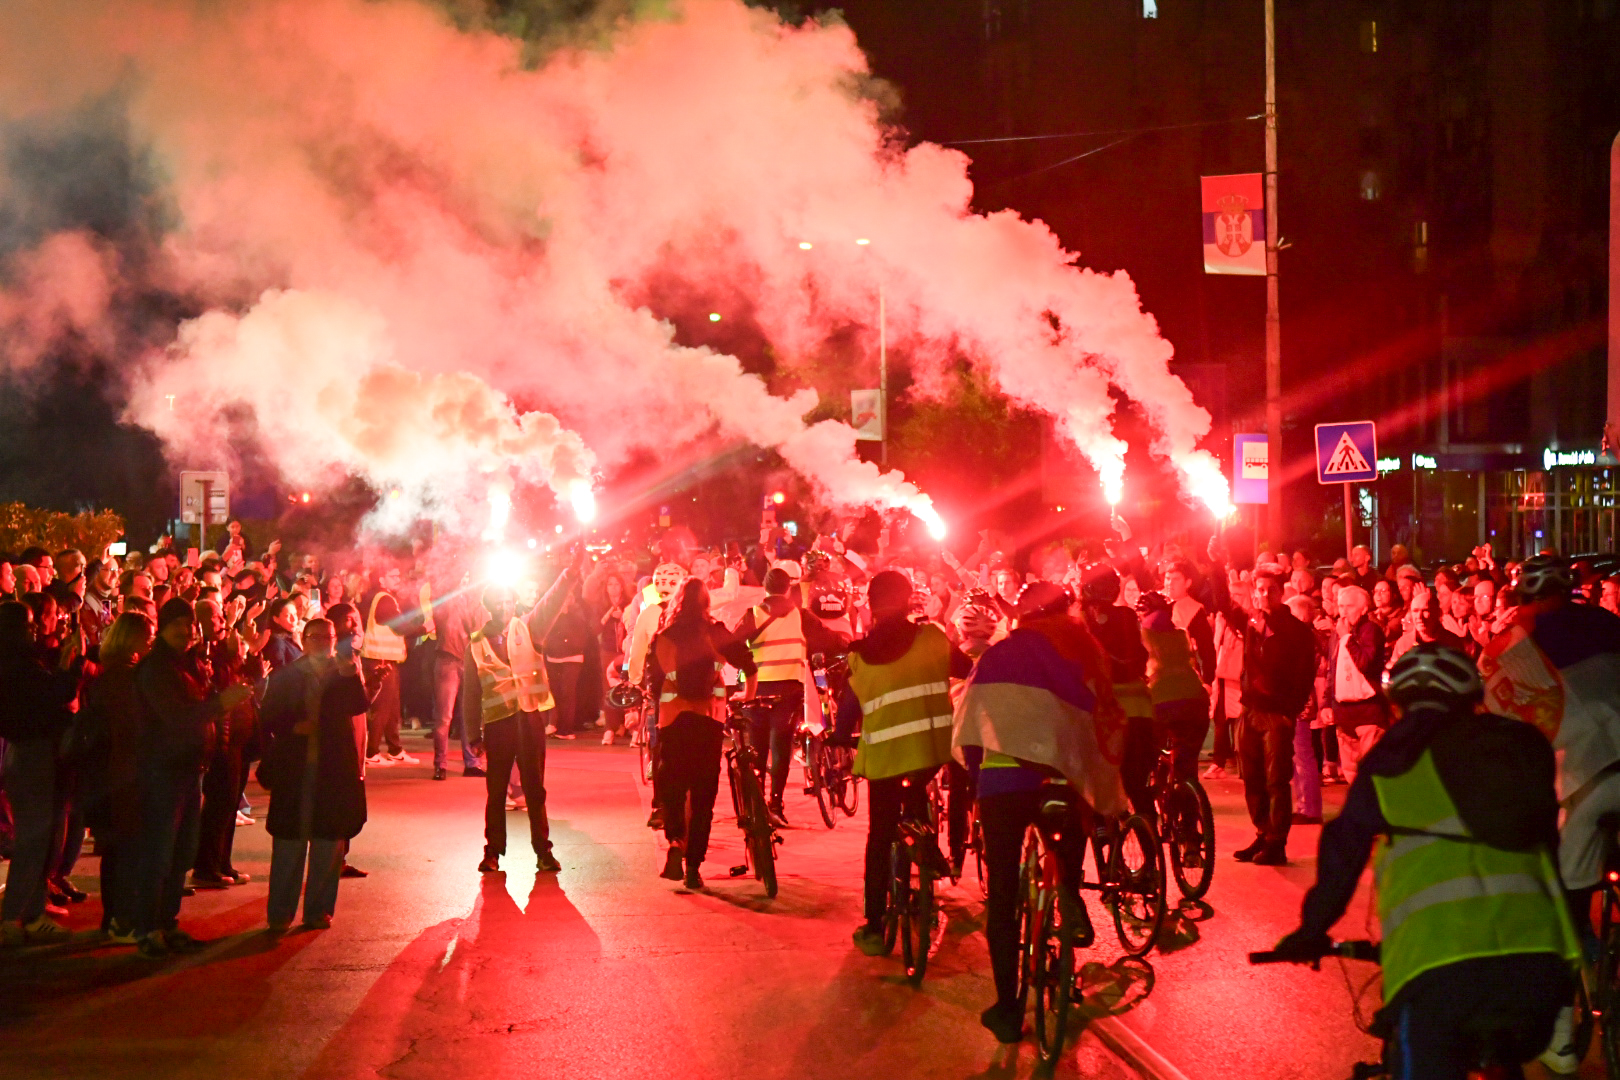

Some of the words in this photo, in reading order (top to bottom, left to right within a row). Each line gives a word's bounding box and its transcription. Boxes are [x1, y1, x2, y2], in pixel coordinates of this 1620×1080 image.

[763, 495, 775, 510] P
[661, 506, 668, 515] P
[820, 602, 842, 611] PUMA
